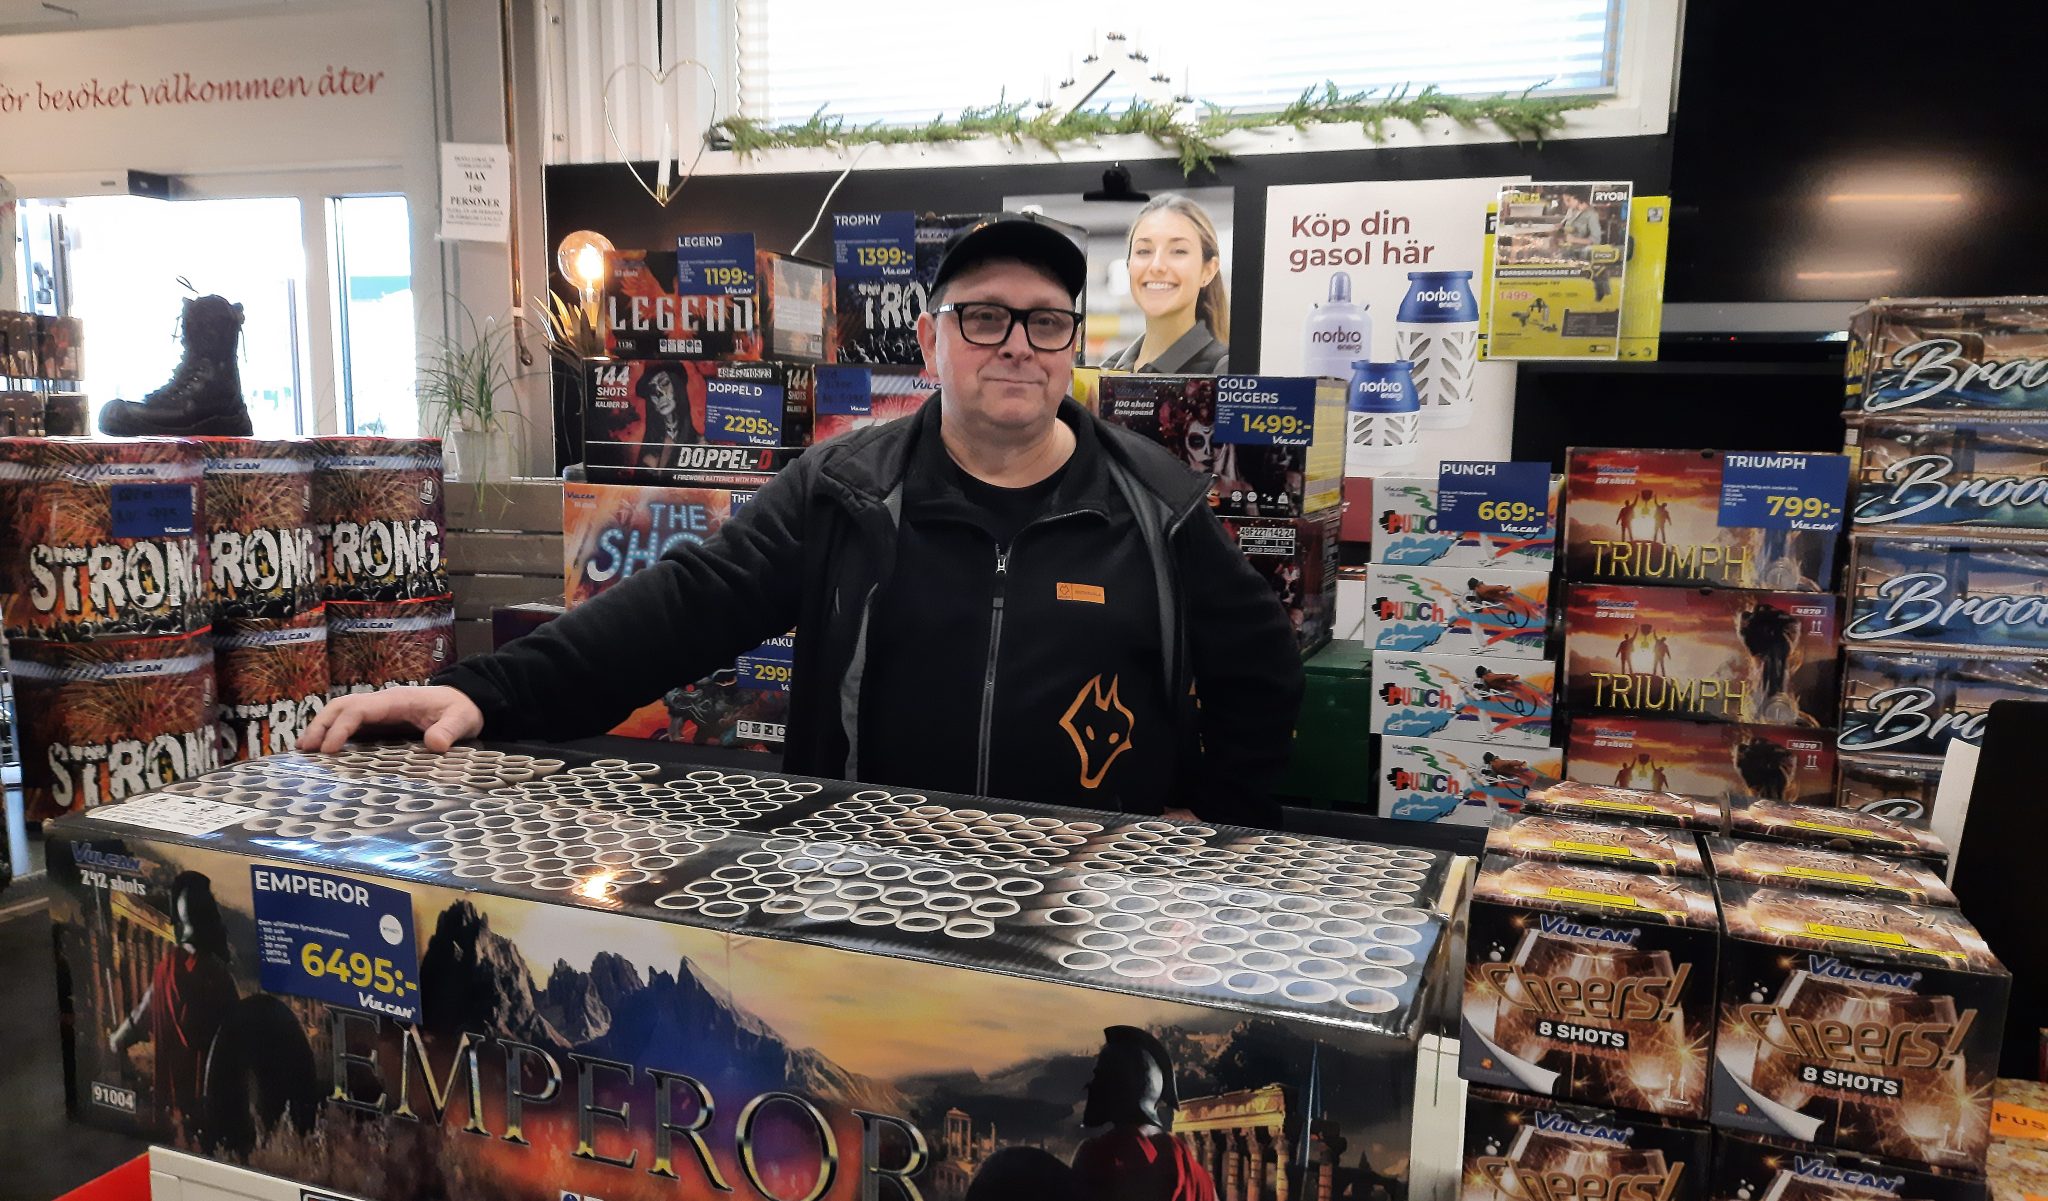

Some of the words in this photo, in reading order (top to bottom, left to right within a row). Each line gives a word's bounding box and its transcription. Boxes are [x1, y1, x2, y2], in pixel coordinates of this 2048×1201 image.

[36, 78, 133, 112] besöket
[140, 72, 313, 108] välkommen
[318, 64, 385, 96] åter
[465, 171, 486, 181] MAX
[450, 196, 500, 208] PERSONER
[1595, 191, 1628, 202] RYOBI
[834, 214, 881, 226] TROPHY
[1292, 212, 1351, 242] Köp
[1361, 210, 1411, 236] din
[678, 236, 722, 248] LEGEND
[857, 246, 913, 266] 1399:-
[1289, 241, 1371, 273] gasol
[1383, 239, 1435, 265] här
[704, 267, 754, 286] 1199:-
[882, 266, 911, 275] VULCAN
[725, 286, 752, 295] VULCAN
[1416, 286, 1462, 302] norbro
[608, 295, 753, 332] LEGEND
[858, 281, 933, 331] TRO
[1312, 326, 1362, 343] norbro
[594, 366, 630, 386] 144
[786, 369, 809, 390] 144
[1218, 378, 1258, 390] GOLD
[1359, 378, 1402, 392] norbro
[597, 387, 628, 397] SHOTS
[708, 382, 752, 396] DOPPEL
[754, 386, 763, 397] D
[1217, 391, 1279, 404] DIGGERS
[724, 414, 779, 436] 2295:-
[1241, 413, 1311, 434] 1499:-
[749, 435, 776, 446] VULCAN
[1272, 436, 1307, 445] VULCAN
[97, 464, 156, 476] VULCAN
[205, 458, 261, 471] VULCAN
[329, 455, 376, 467] VULCAN
[1441, 464, 1496, 476] PUNCH
[1726, 456, 1807, 470] TRIUMPH
[1611, 478, 1637, 486] shots
[649, 503, 708, 530] THE
[1478, 501, 1545, 522] 669:-
[1766, 495, 1841, 519] 799:-
[1501, 524, 1541, 533] VULCAN
[1790, 520, 1835, 531] VULCAN
[1590, 540, 1750, 582] TRIUMPH
[345, 617, 394, 629] VULCAN
[1611, 611, 1636, 619] shots
[264, 632, 311, 643] VULCAN
[762, 637, 793, 648] TAKU
[103, 662, 163, 676] VULCAN
[1590, 672, 1750, 715] TRIUMPH
[1609, 740, 1634, 749] shots
[71, 841, 141, 870] VULCAN
[80, 870, 108, 889] 242
[110, 875, 146, 896] shots
[255, 871, 369, 907] EMPEROR
[1540, 914, 1632, 943] VULCAN
[301, 942, 417, 997] 6495:-
[1808, 954, 1913, 988] VULCAN
[1481, 962, 1692, 1022] Cheers!
[359, 991, 412, 1019] VULCAN
[1539, 1021, 1553, 1036] 8
[1556, 1024, 1626, 1047] SHOTS
[1740, 1008, 1978, 1069] Cheers!
[1803, 1066, 1818, 1082] 8
[1822, 1070, 1899, 1095] SHOTS
[94, 1086, 134, 1109] 91004
[325, 1003, 932, 1201] EMPEROR
[1535, 1111, 1627, 1143] VULCAN
[1793, 1155, 1896, 1190] VULCAN
